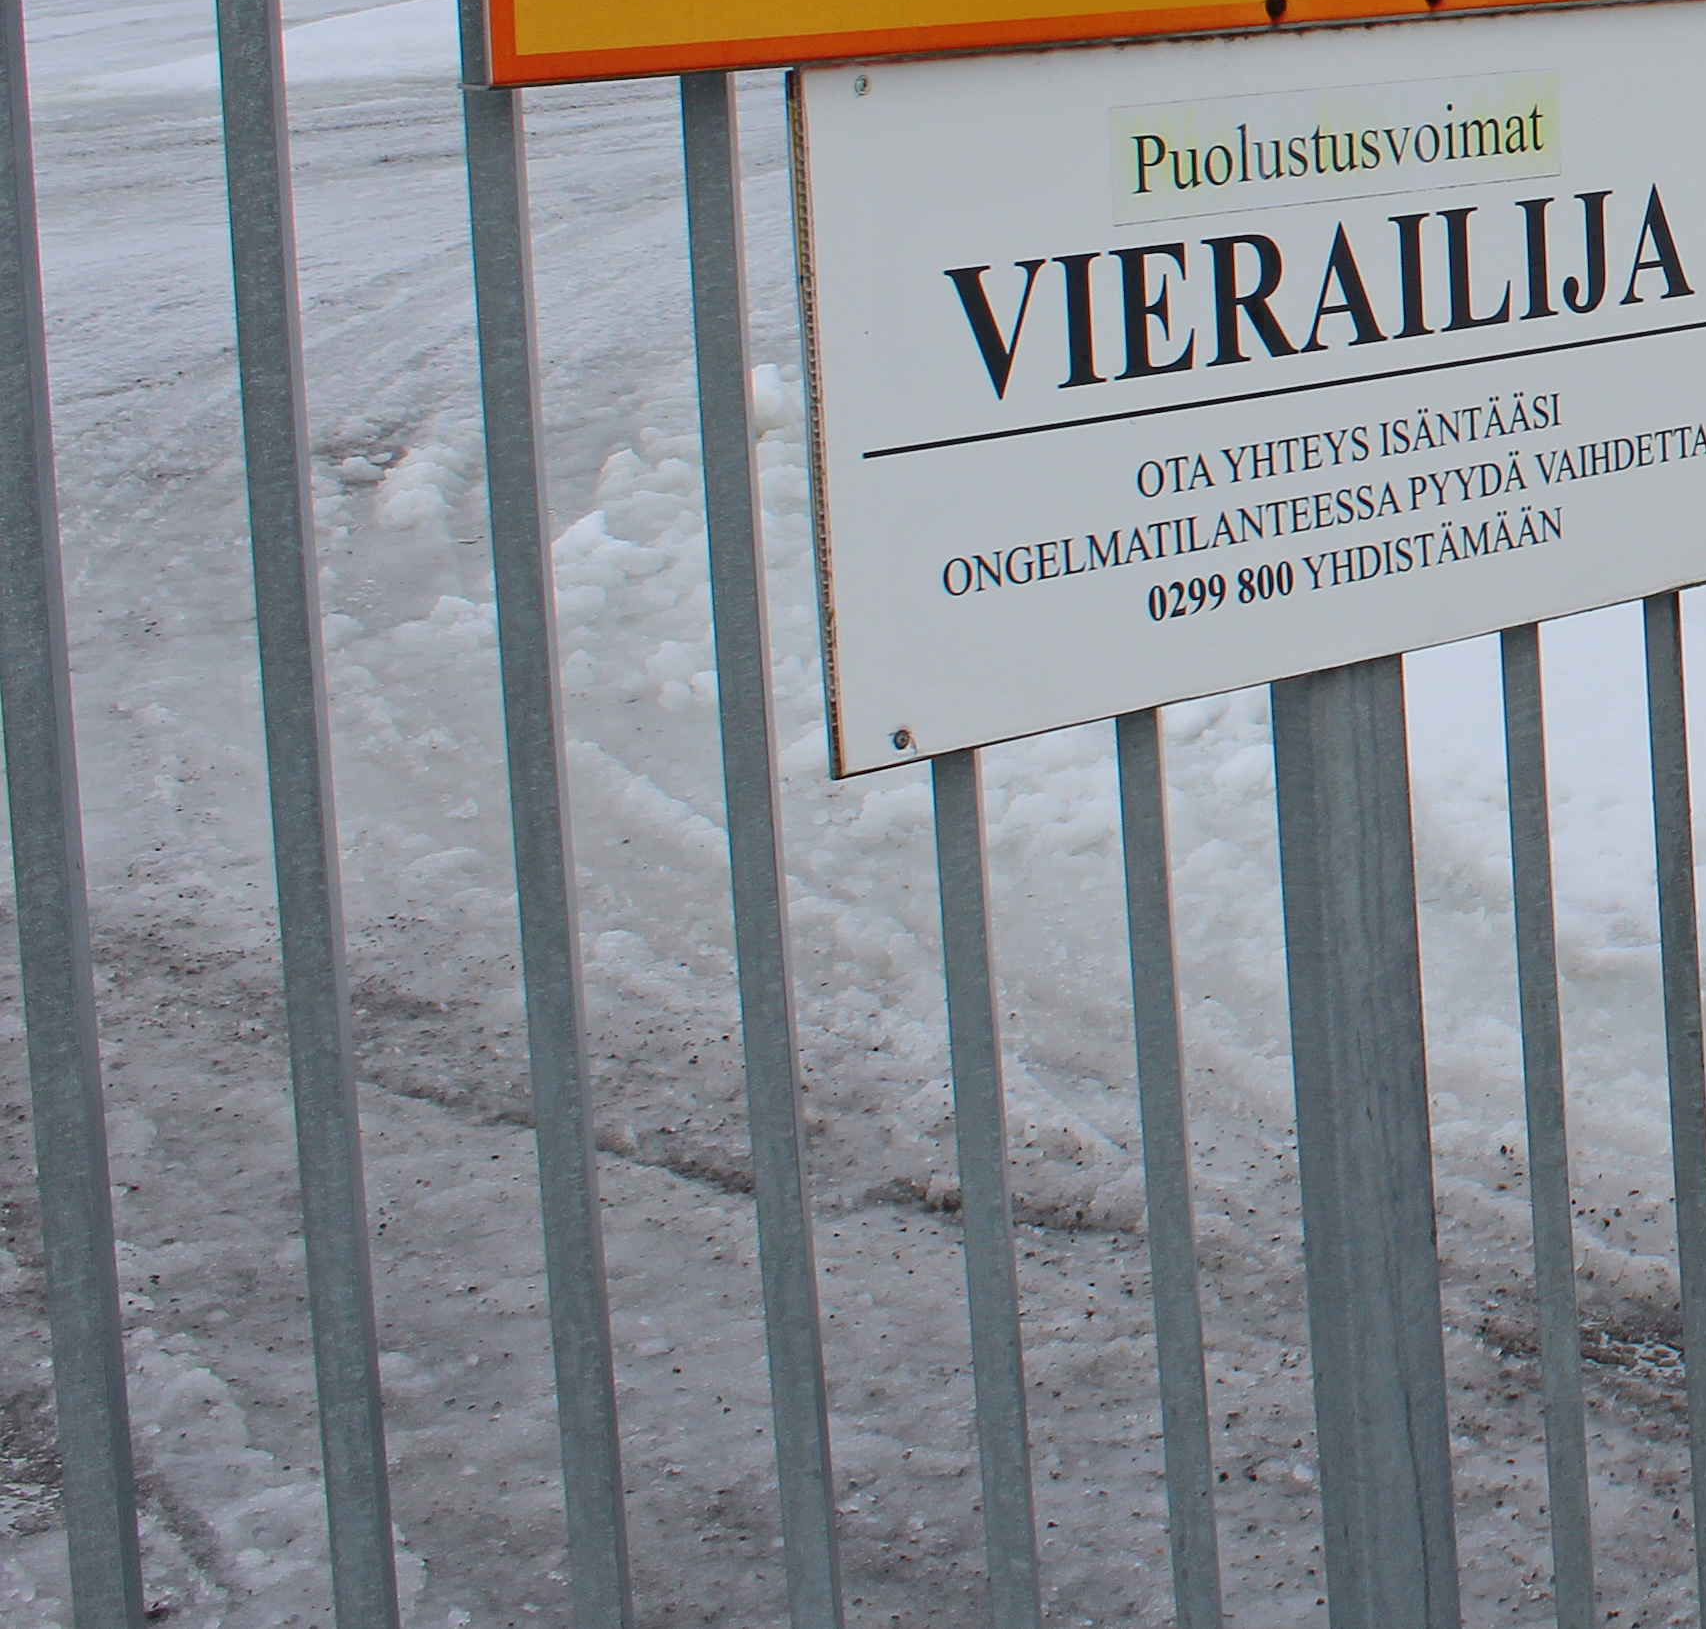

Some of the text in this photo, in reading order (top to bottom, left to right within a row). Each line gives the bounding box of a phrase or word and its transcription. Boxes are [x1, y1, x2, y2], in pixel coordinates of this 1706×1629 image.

[1132, 104, 1543, 193] Puolustusvoimat
[944, 184, 1694, 400] VIERAILIJA
[1138, 392, 1560, 497] OTA YHTEYS ISÄNTÄÄSI
[943, 483, 1401, 598] ONGELMATILANTEESSA
[1409, 459, 1527, 511] PYYDÄ
[1149, 507, 1561, 621] 0299 800 YHDISTÄMÄÄN
